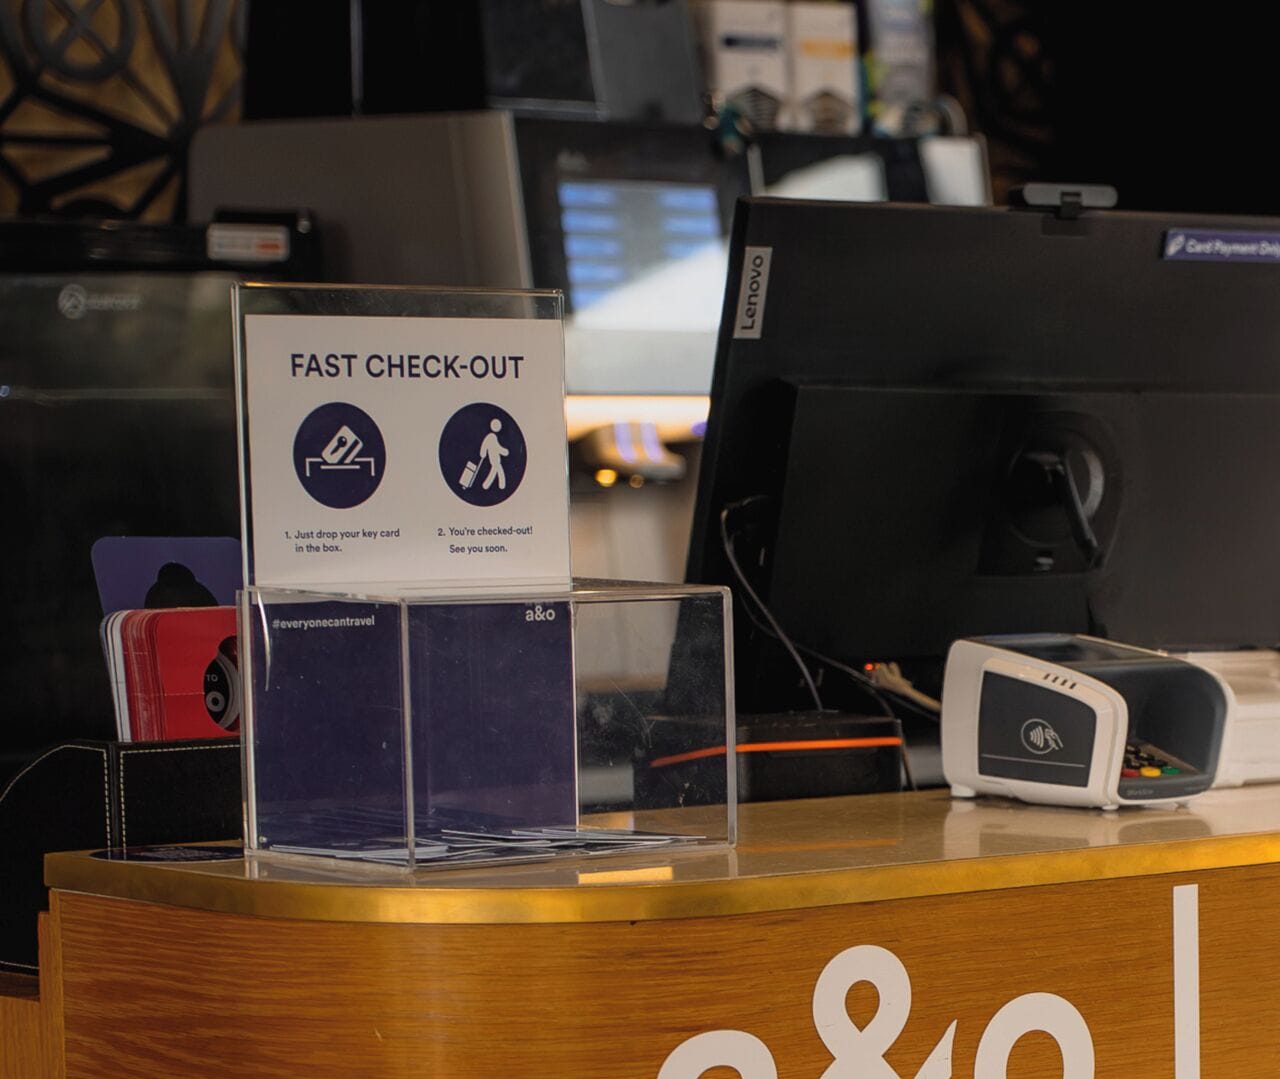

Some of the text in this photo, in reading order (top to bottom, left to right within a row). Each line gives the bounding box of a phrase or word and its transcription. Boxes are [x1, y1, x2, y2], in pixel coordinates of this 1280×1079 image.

[740, 254, 764, 330] Lenovo
[290, 353, 524, 379] FAST CHECK-OUT
[284, 528, 400, 540] 1. Just drop your key card
[437, 525, 533, 536] 2. You're checked-out!
[295, 542, 342, 552] in the box.
[449, 544, 508, 554] See you soon.
[525, 605, 556, 622] a&o
[272, 614, 375, 630] #everyonecantravel
